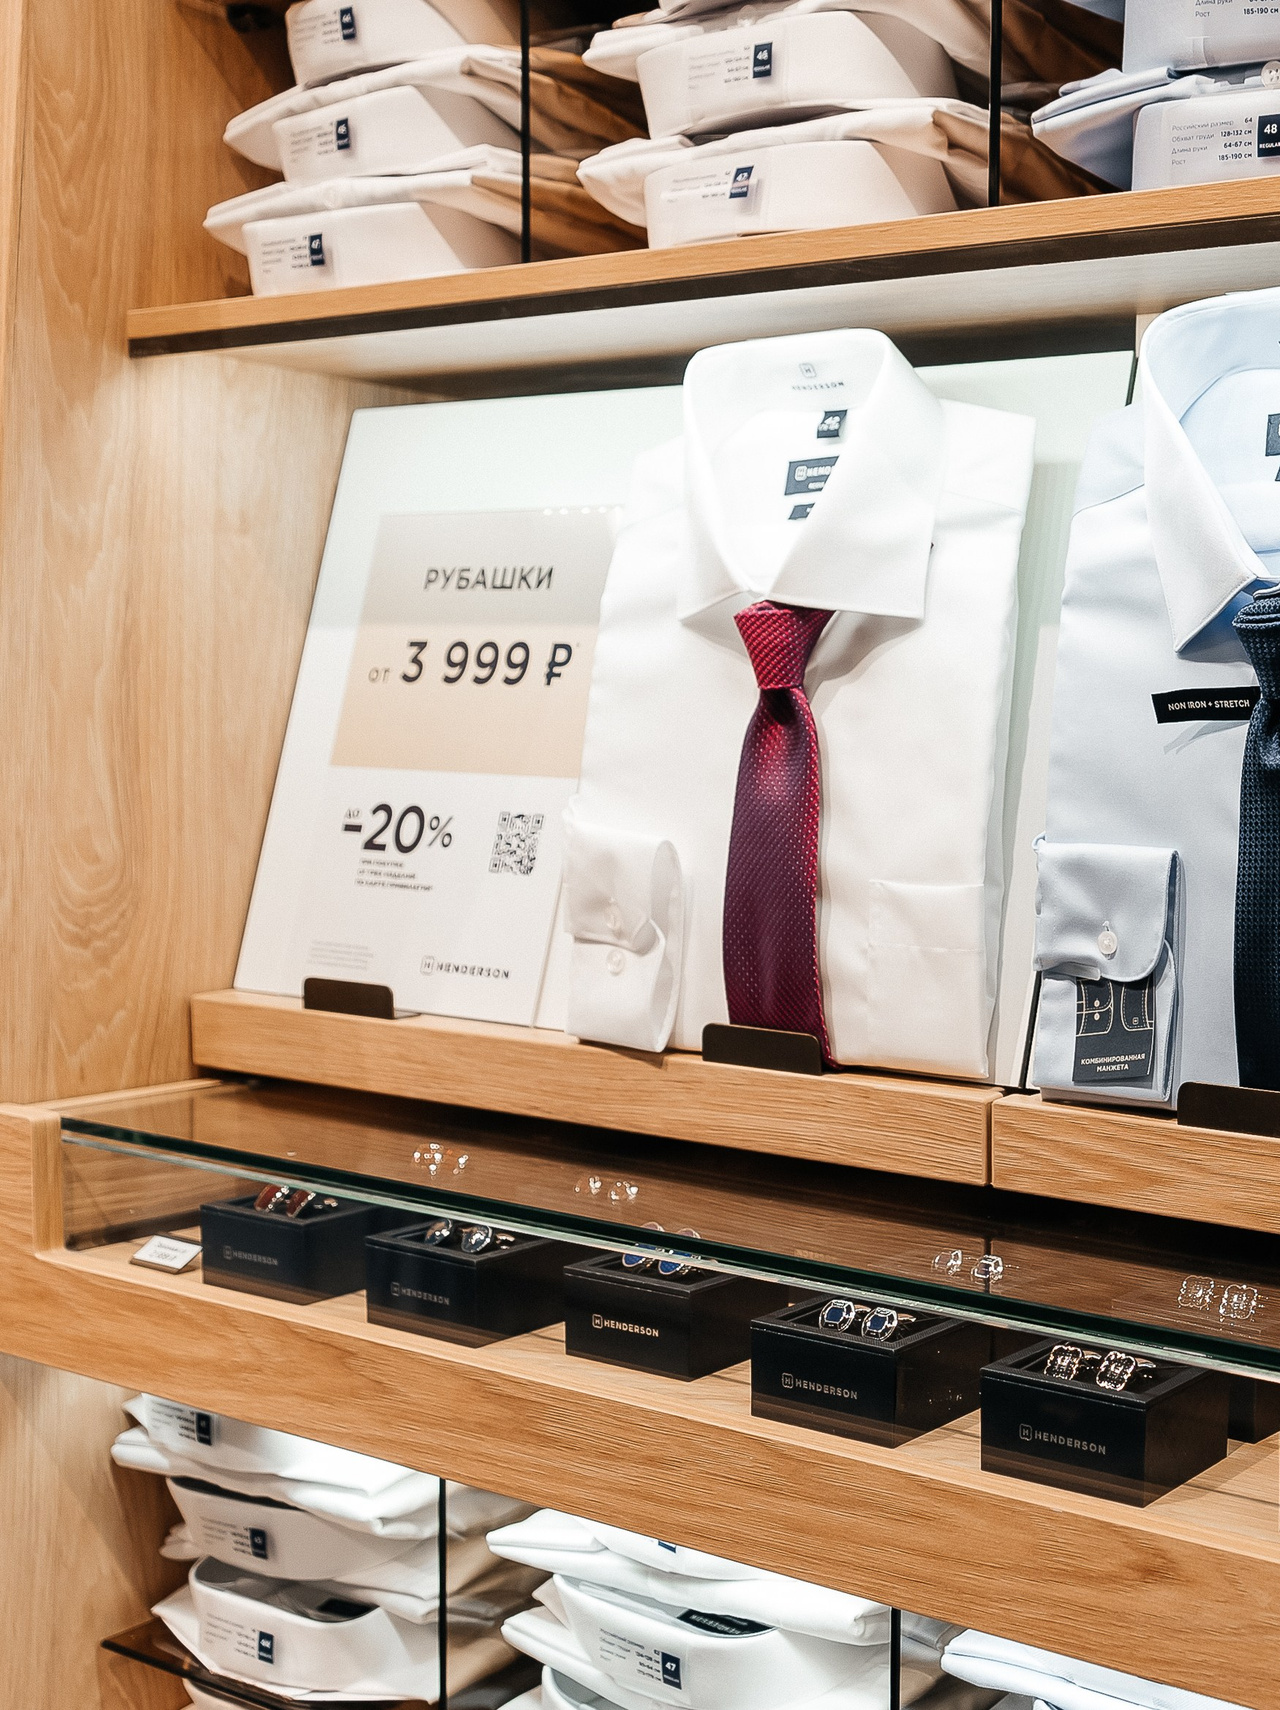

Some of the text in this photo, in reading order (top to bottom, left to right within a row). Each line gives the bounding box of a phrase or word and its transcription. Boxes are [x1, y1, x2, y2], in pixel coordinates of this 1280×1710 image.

[1243, 7, 1269, 15] 185-190
[1172, 122, 1209, 131] Российский
[1220, 129, 1243, 137] 128-132
[1263, 123, 1278, 134] 48
[1171, 147, 1192, 155] Длина
[1223, 141, 1242, 149] 64-67
[1218, 153, 1243, 161] 185-190
[424, 566, 554, 590] РУБАШКИ
[402, 641, 428, 683] 3
[443, 641, 530, 685] 999
[1168, 701, 1187, 711] NON
[1187, 700, 1207, 709] IRON
[1214, 699, 1250, 708] STRETCH
[436, 962, 509, 978] HENDERSON
[1081, 1053, 1145, 1065] КОМБИНИРОВАННАЯ
[1096, 1063, 1129, 1072] МАНЖЕТА
[232, 1251, 279, 1266] HENDERSON
[401, 1288, 450, 1305] HENDERSON
[604, 1319, 659, 1337] HENDERSON
[795, 1378, 858, 1400] HENDERSON
[1034, 1430, 1106, 1455] HENDERSON
[665, 1661, 677, 1671] 47
